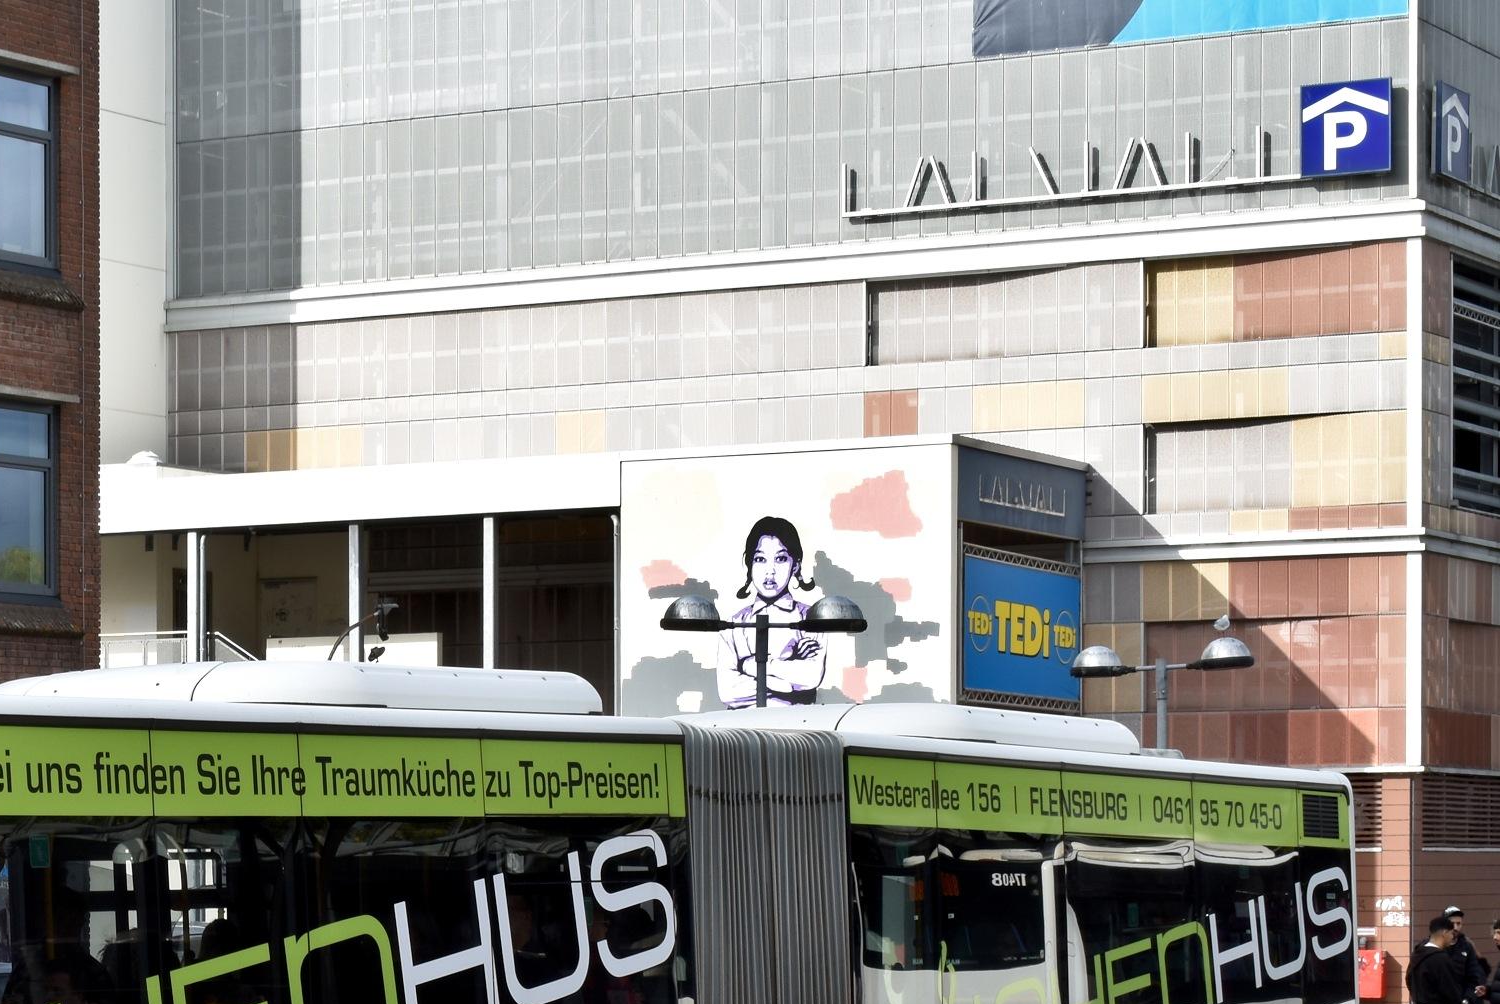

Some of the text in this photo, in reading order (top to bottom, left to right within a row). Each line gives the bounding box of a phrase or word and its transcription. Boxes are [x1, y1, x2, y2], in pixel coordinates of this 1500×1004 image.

[1323, 111, 1367, 171] P
[1447, 114, 1462, 172] P
[967, 609, 992, 636] TEDi
[995, 600, 1050, 659] TEDi
[1053, 624, 1076, 649] TEDi
[25, 761, 83, 794] uns
[94, 751, 186, 795] finden
[196, 753, 241, 795] Sie
[252, 754, 307, 796] Ihre
[315, 756, 476, 798] Traumküche
[484, 771, 512, 799] zu
[518, 760, 660, 809] Top-Preisen!
[853, 774, 961, 811] Westerallee
[966, 782, 1002, 813] 156
[1029, 786, 1128, 821] FLENSBURG
[1152, 795, 1193, 825] 0461
[1200, 798, 1220, 827] 95
[1224, 801, 1245, 828] 70
[1250, 802, 1282, 831] 45-0
